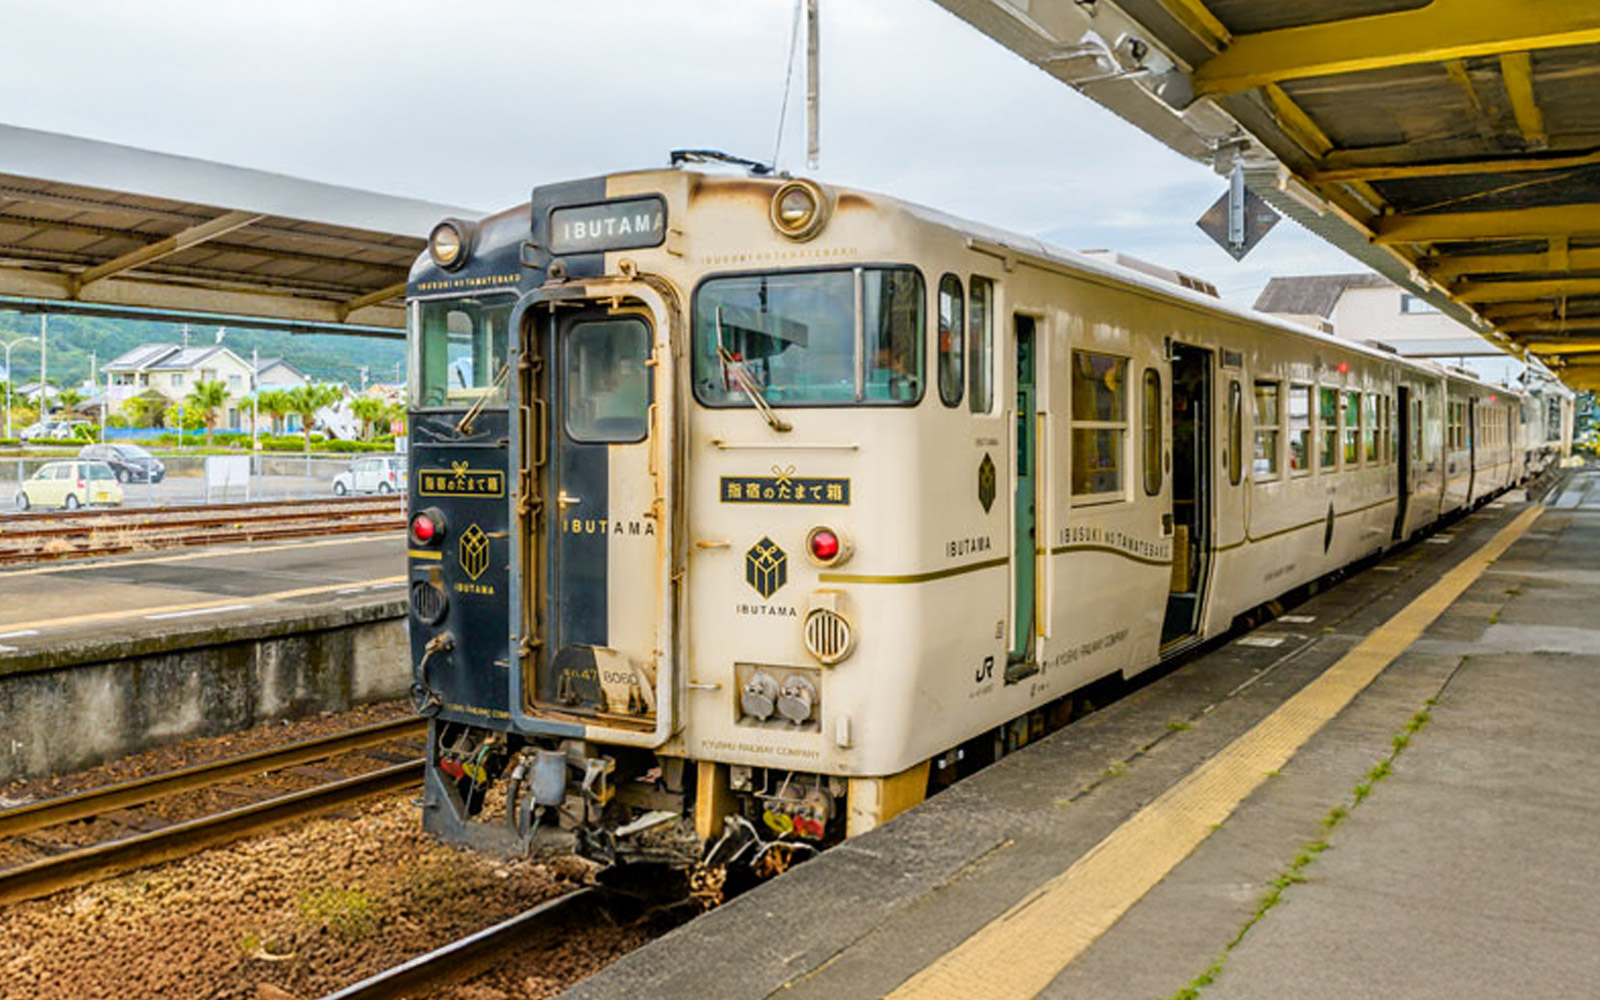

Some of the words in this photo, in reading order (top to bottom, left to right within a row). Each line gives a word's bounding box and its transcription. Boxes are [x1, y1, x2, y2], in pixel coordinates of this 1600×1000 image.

[562, 517, 655, 536] IBUTAMA
[1059, 525, 1103, 545] IBUSUKI
[945, 536, 992, 558] IBUTAMA
[735, 604, 798, 617] IBUTAMA
[976, 655, 995, 684] JR
